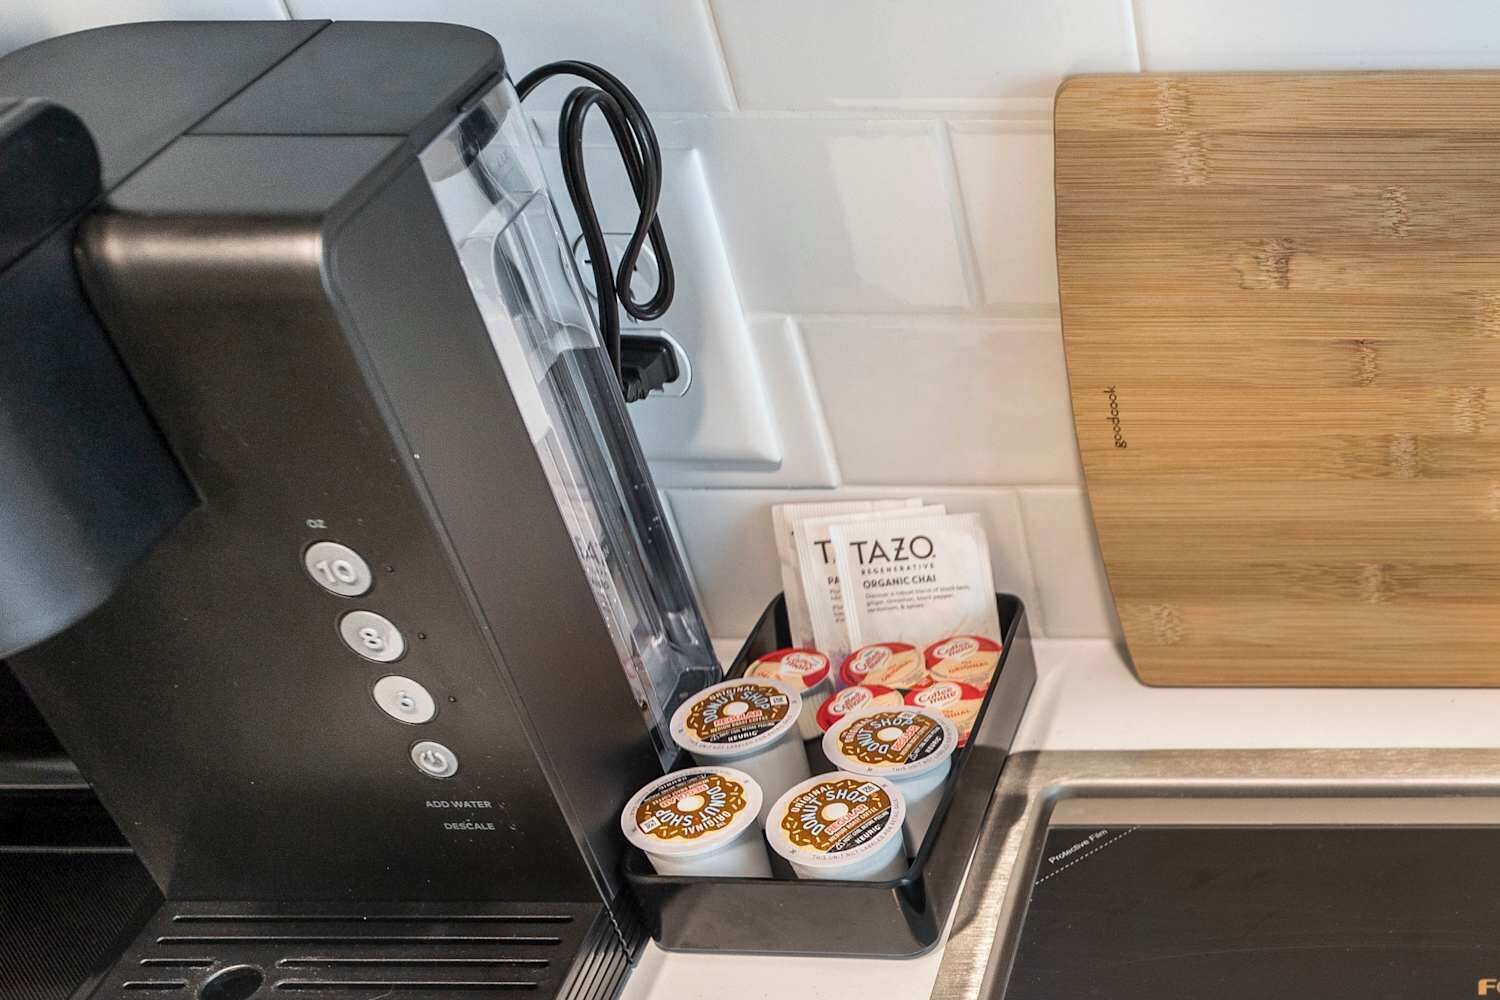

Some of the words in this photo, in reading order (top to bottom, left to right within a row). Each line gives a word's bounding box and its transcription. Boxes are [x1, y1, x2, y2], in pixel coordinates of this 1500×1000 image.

[315, 560, 357, 584] 10
[863, 576, 911, 590] ORGANIC
[912, 574, 936, 586] CHAI
[358, 627, 384, 650] 8
[703, 692, 736, 724] DONUT
[740, 690, 771, 710] SHOP
[870, 718, 914, 729] SHOP
[727, 731, 759, 743] KEURIG
[857, 728, 889, 754] DONUT
[425, 800, 450, 809] ADD
[451, 800, 492, 809] WATER
[699, 786, 727, 822] DONUT
[791, 784, 834, 813] ORIGINAL
[655, 809, 693, 827] SHOP
[684, 810, 731, 836] ORIGINAL
[801, 797, 826, 836] DONUT
[826, 789, 868, 803] SHOP
[444, 822, 496, 831] DESCALE
[855, 825, 881, 844] KEURIG
